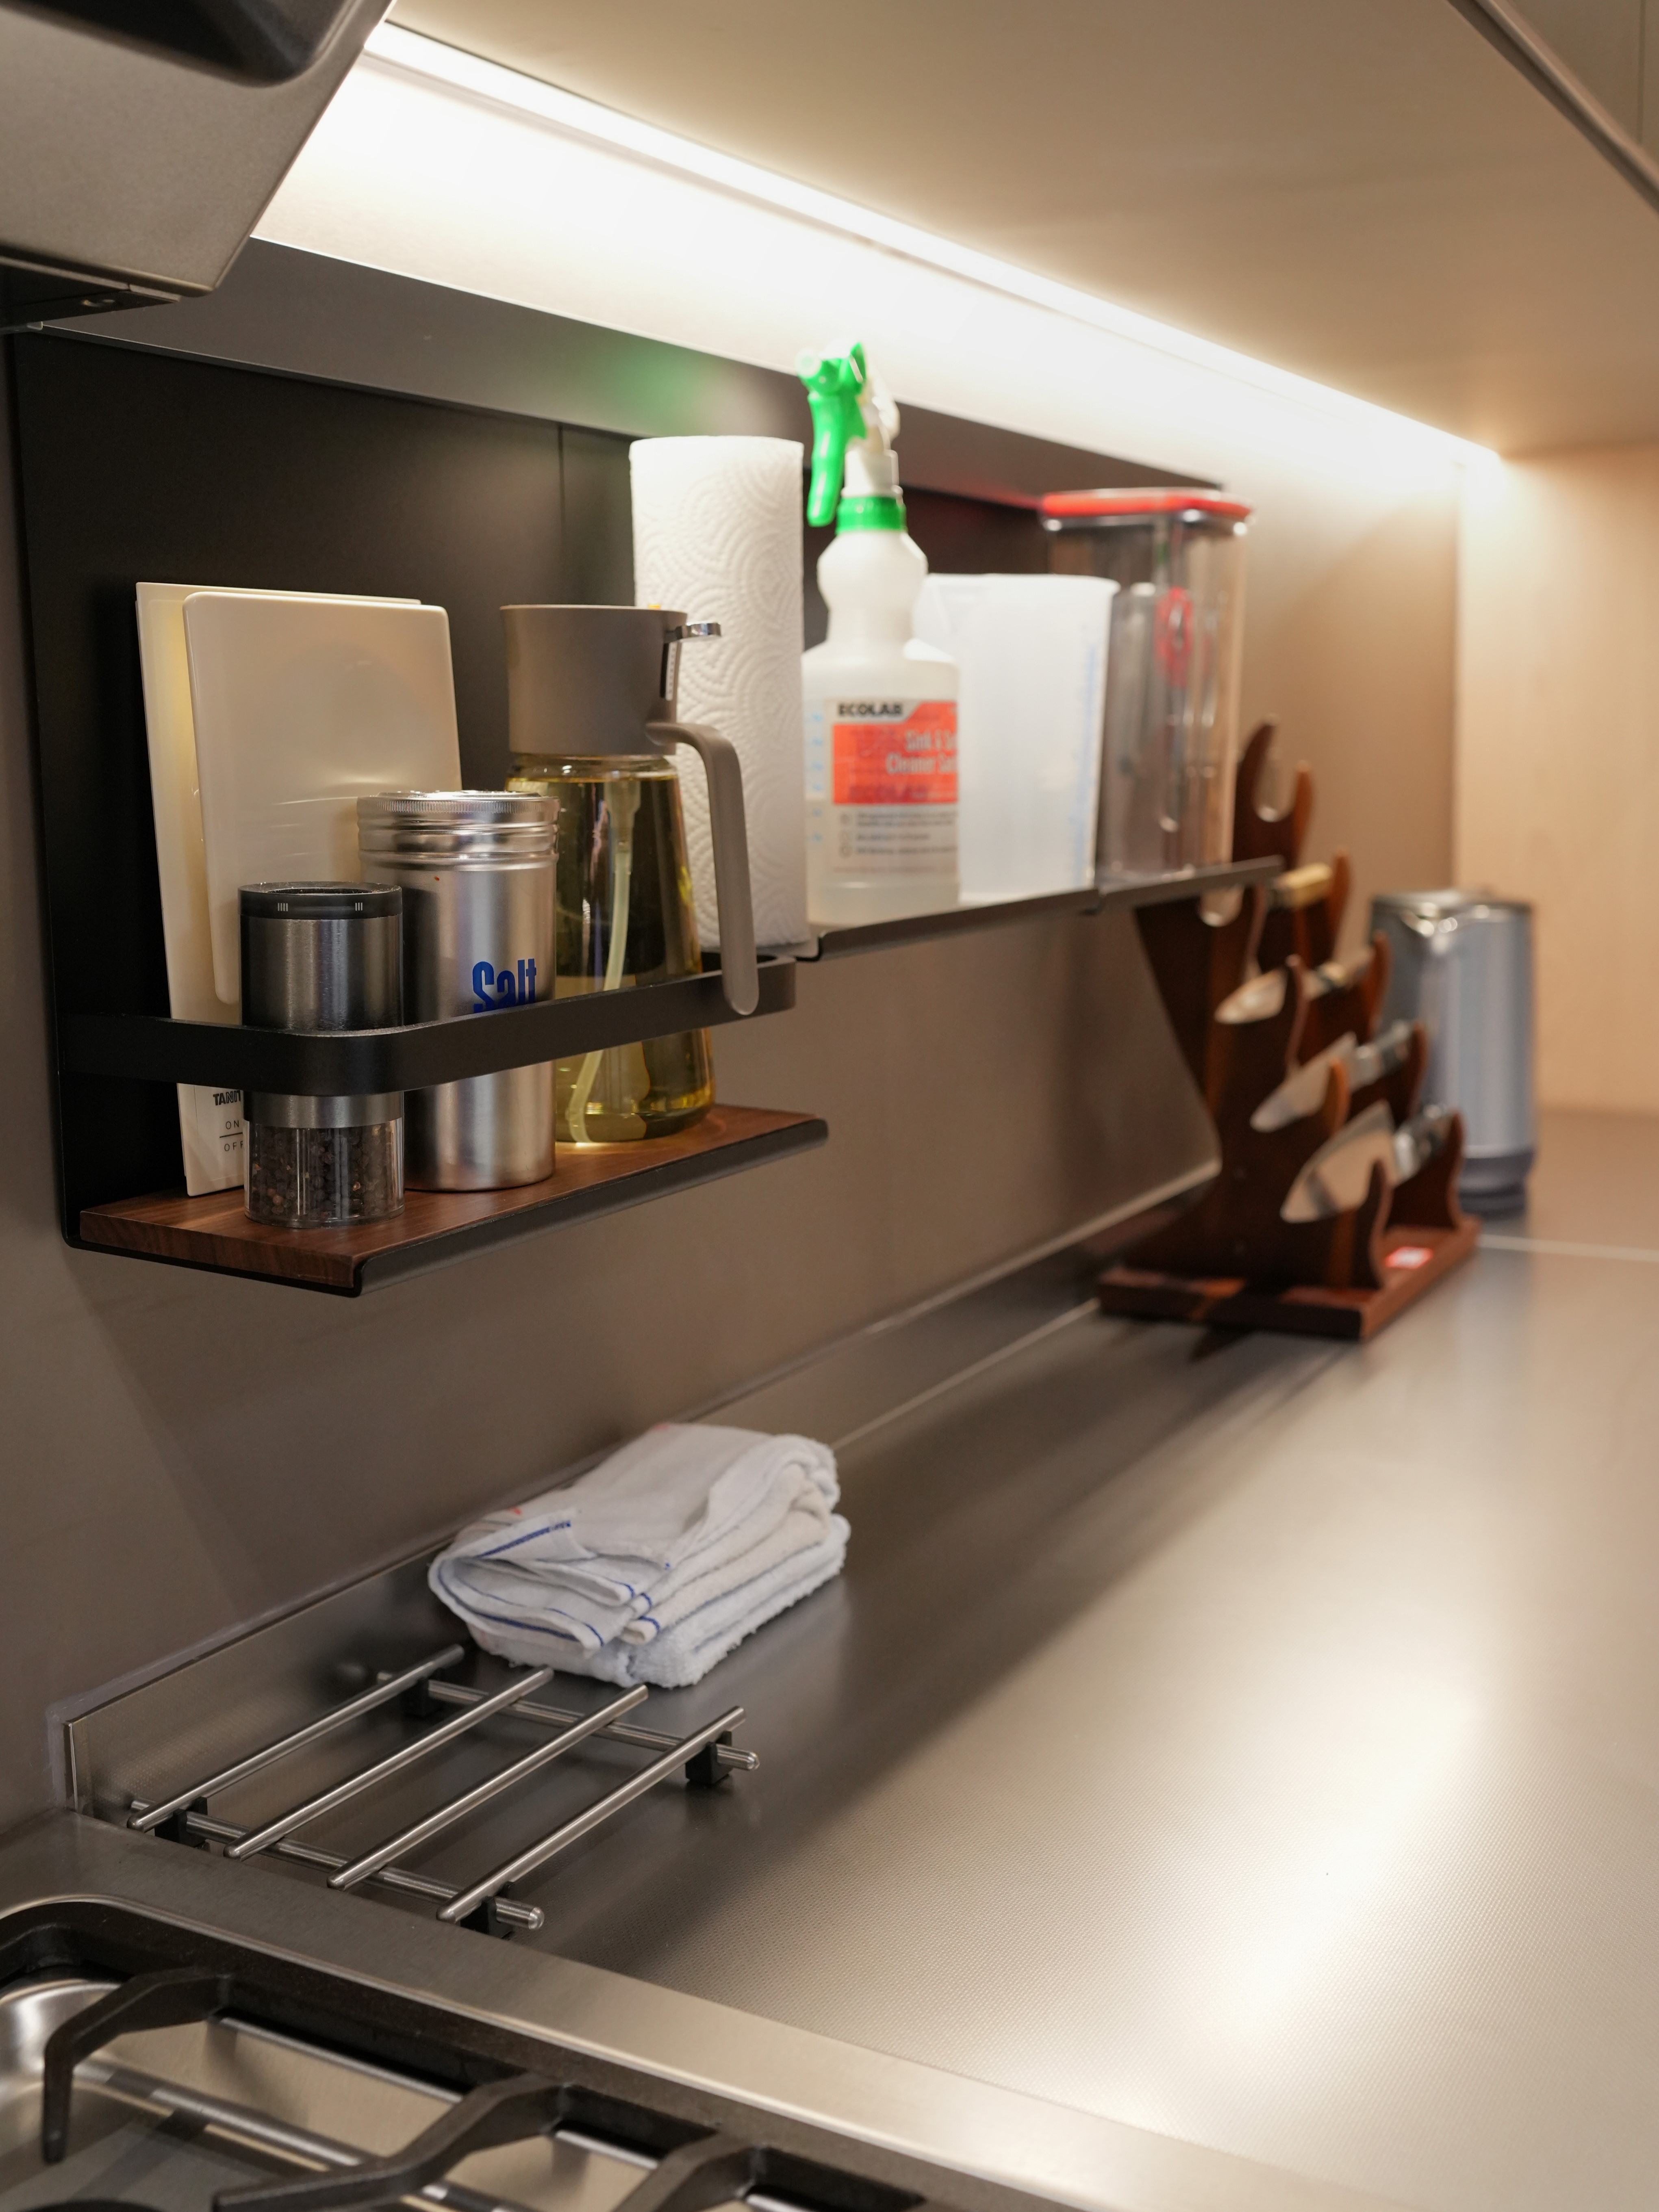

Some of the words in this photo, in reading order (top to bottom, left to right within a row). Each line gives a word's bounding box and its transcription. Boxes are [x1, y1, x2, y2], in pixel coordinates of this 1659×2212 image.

[838, 703, 902, 716] ECOLAB
[473, 958, 536, 1013] Salt
[226, 1120, 239, 1130] ON
